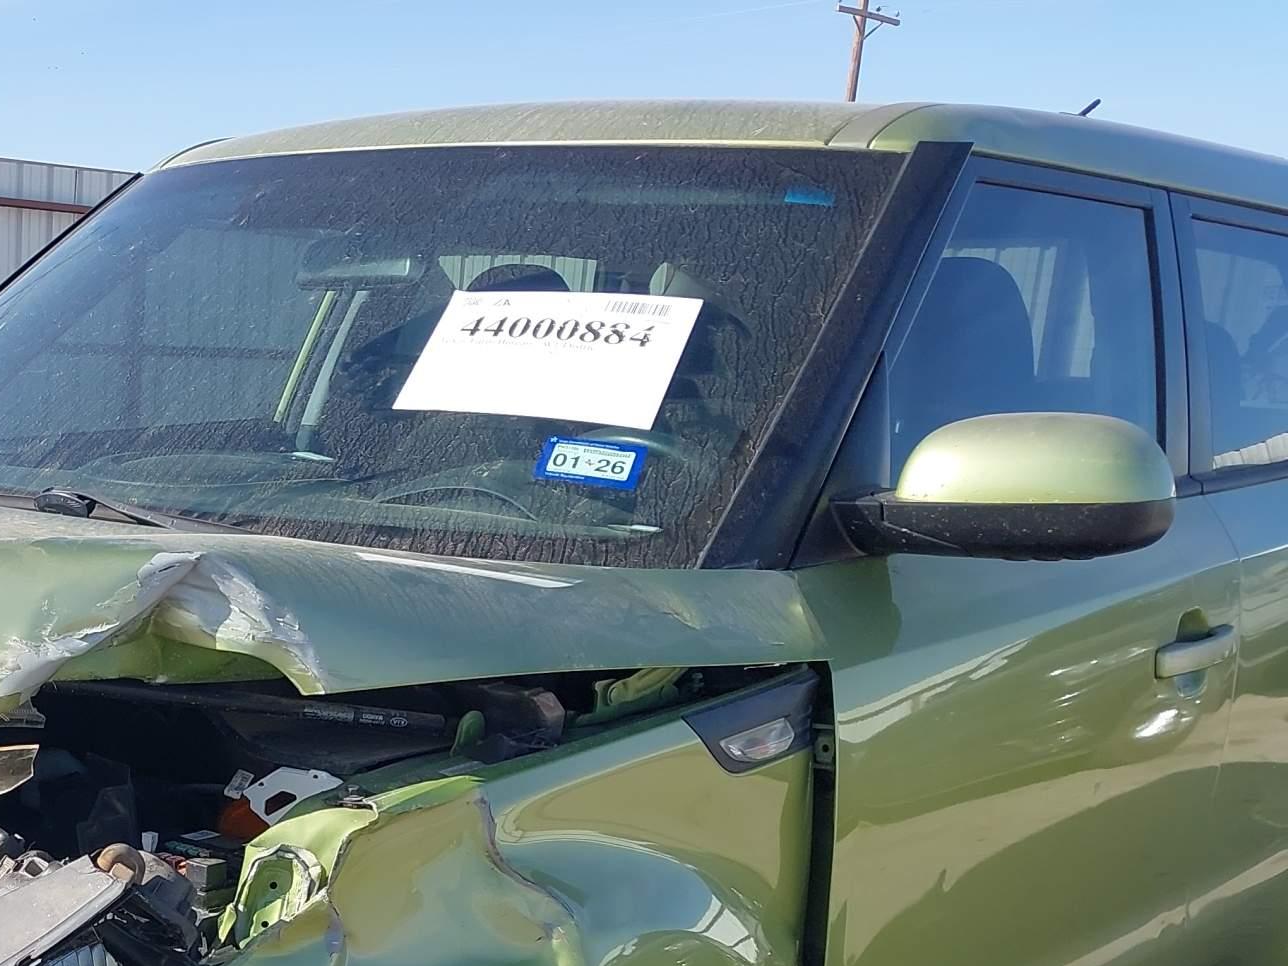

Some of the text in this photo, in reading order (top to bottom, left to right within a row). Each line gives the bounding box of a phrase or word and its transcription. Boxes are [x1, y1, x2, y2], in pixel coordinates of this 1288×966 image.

[460, 316, 655, 347] 44000884
[552, 453, 627, 475] 01 26
